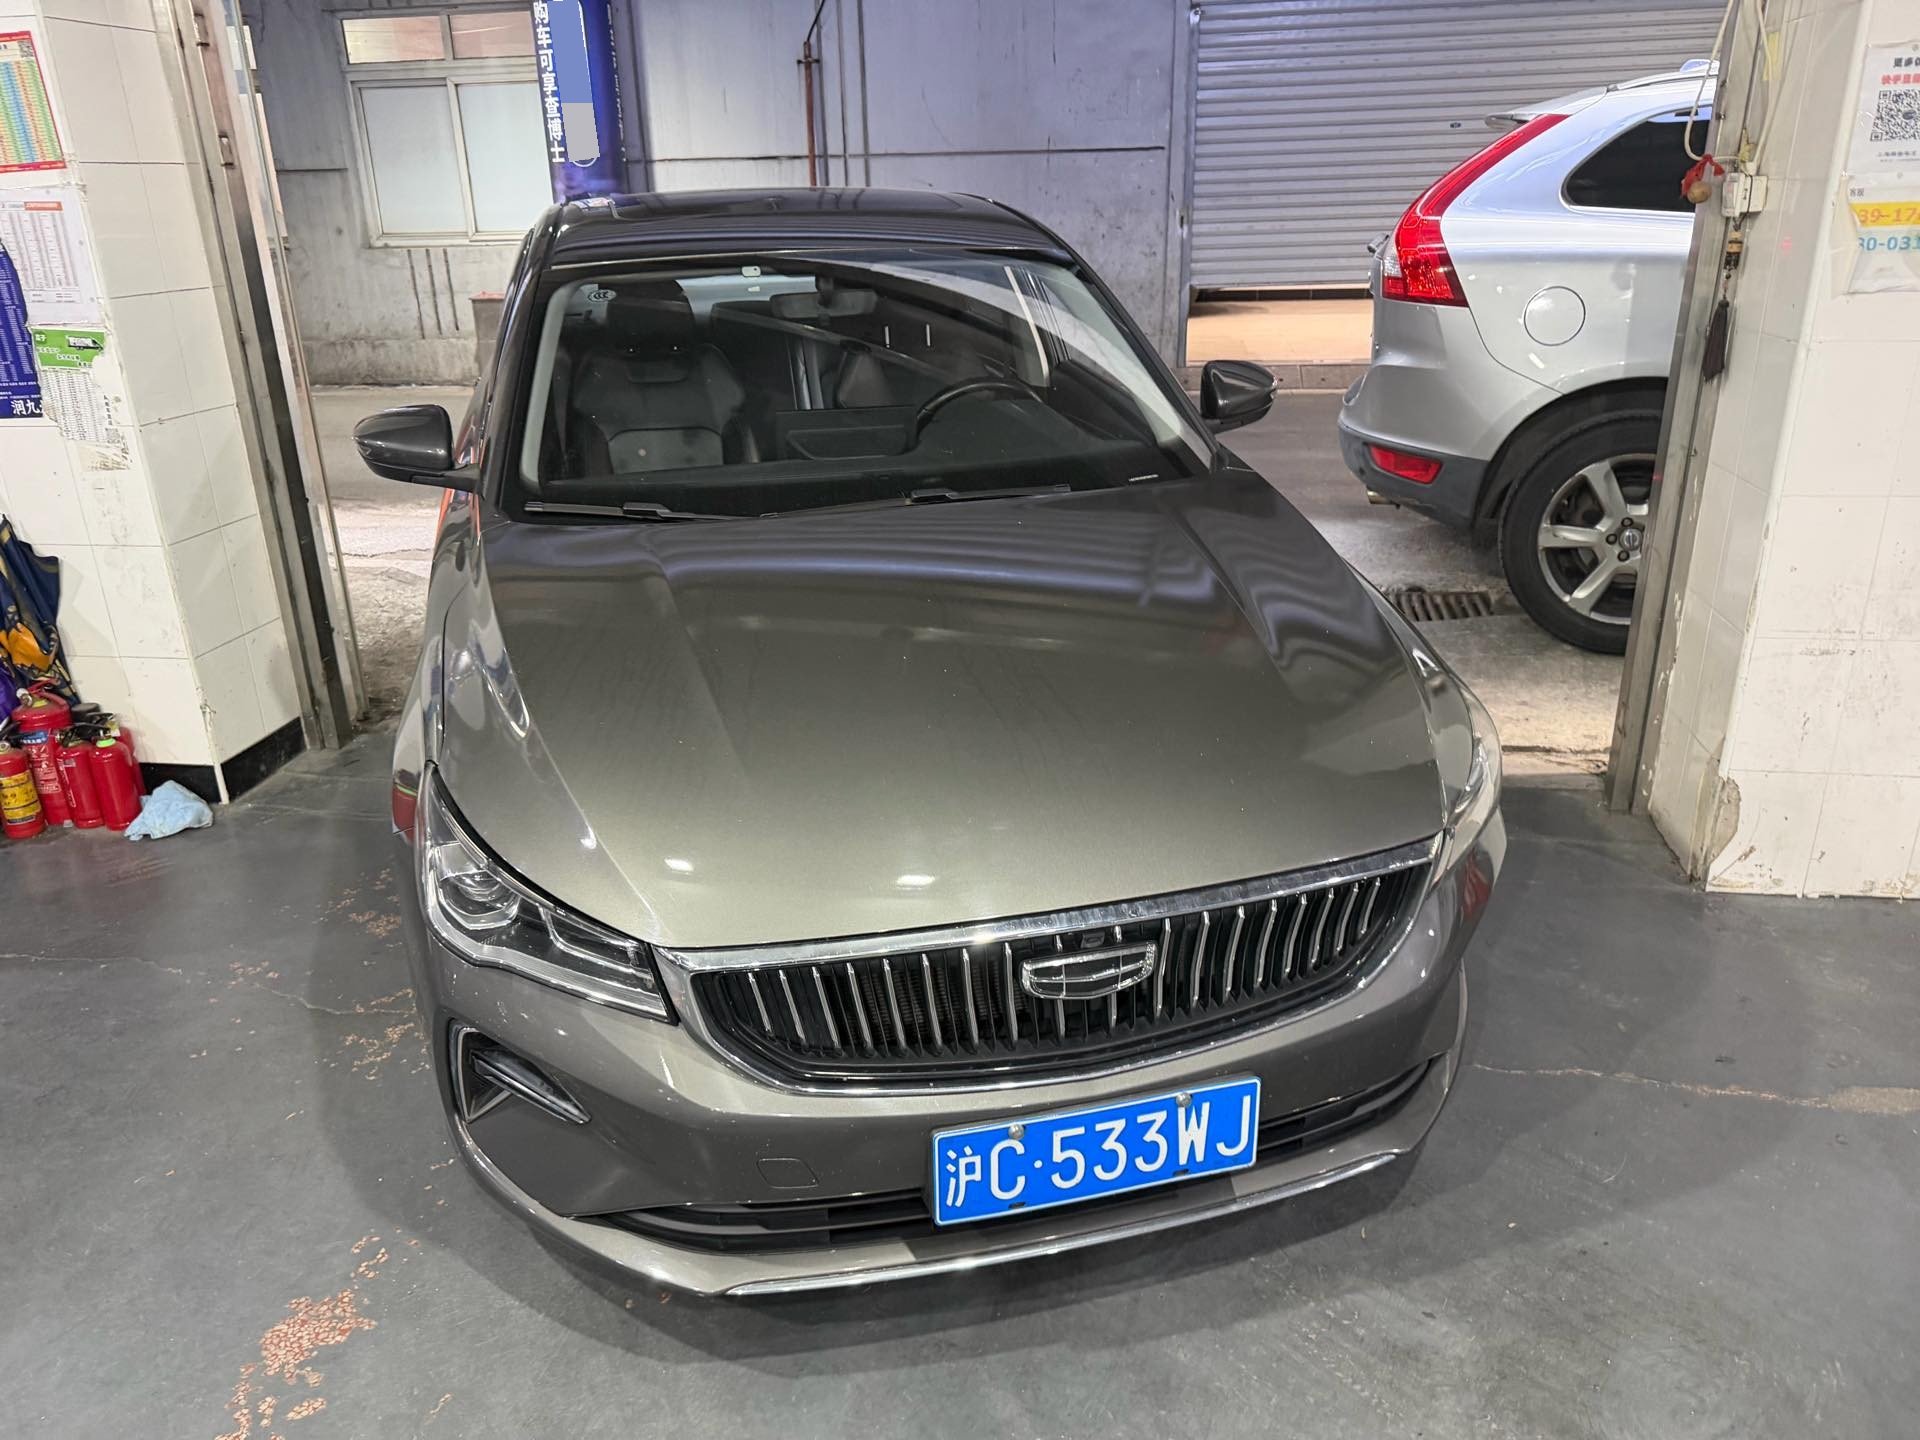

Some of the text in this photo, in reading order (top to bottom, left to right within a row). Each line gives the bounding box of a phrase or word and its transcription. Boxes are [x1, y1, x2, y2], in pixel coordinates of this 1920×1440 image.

[533, 0, 565, 163] 购车可享查博士
[1859, 207, 1920, 223] 39-17
[945, 1094, 1252, 1208] 沪C·533WJ
